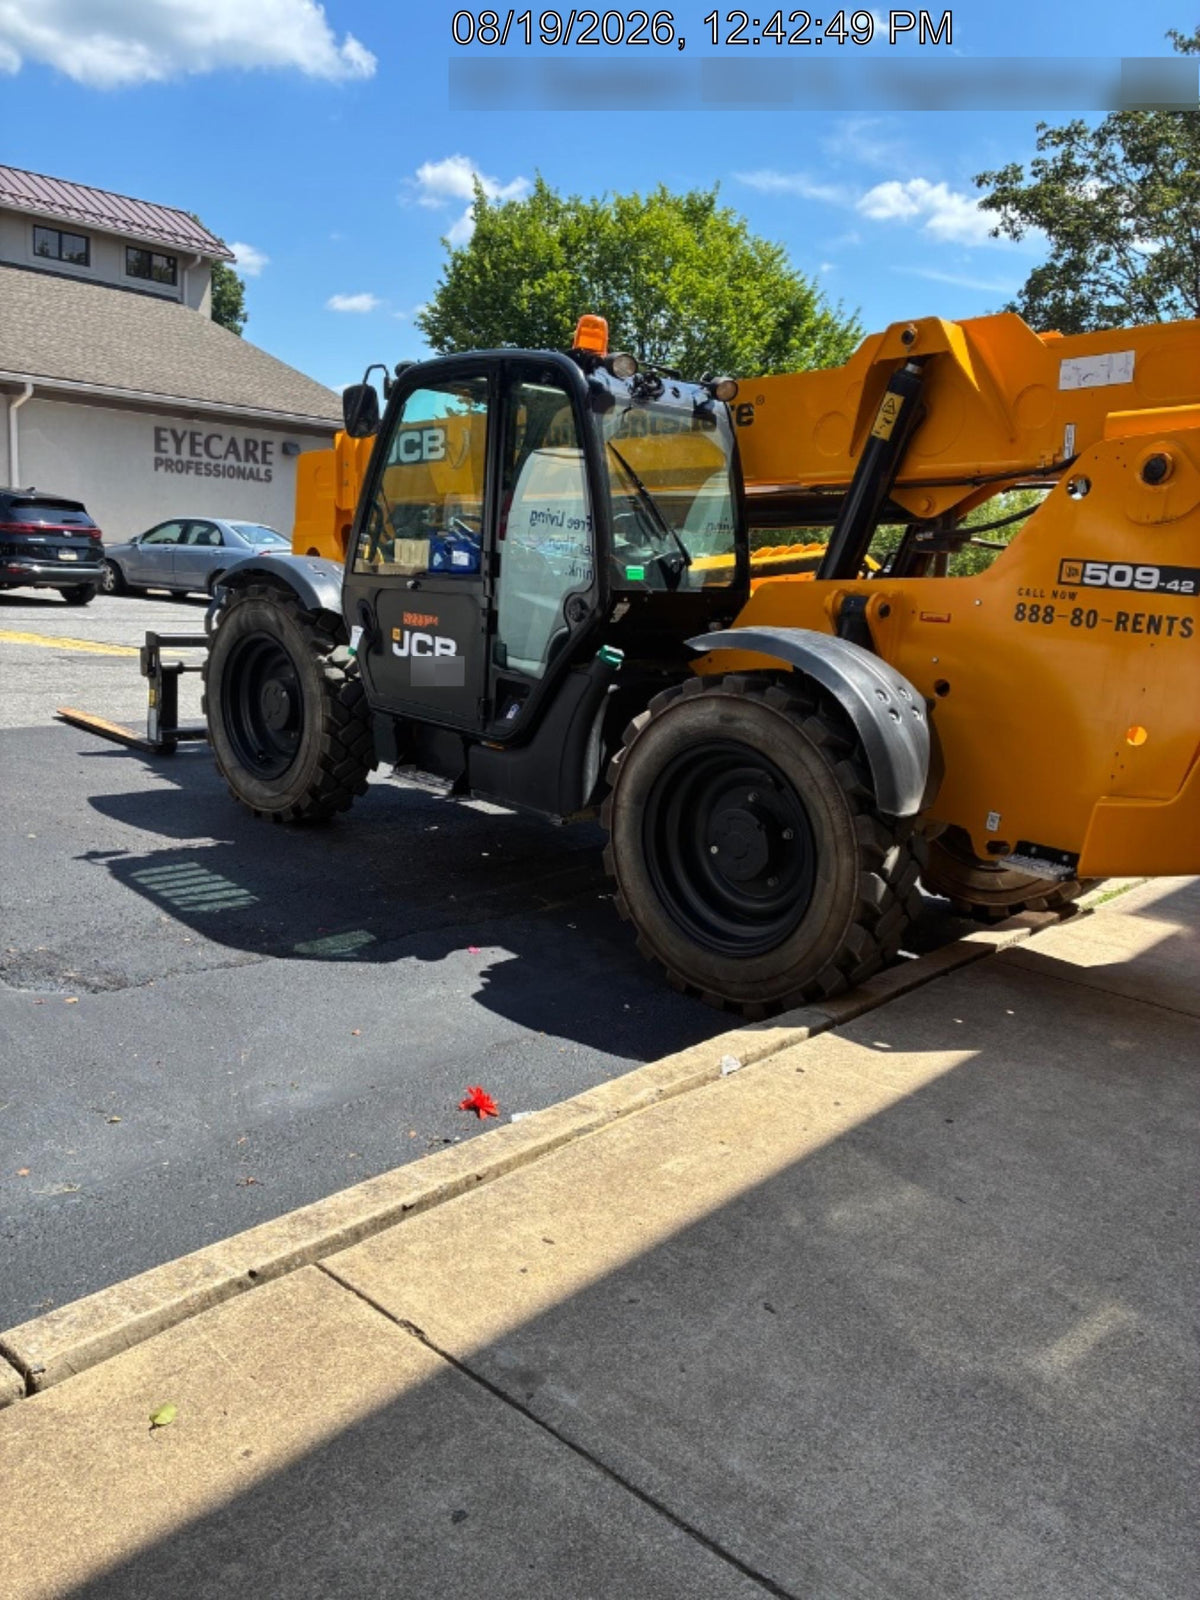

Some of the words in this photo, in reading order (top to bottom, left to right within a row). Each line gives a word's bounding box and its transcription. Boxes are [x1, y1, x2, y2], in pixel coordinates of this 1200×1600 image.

[154, 426, 274, 466] EYECARE
[154, 457, 273, 483] PROFESSIONALS
[1083, 562, 1195, 593] 509-42
[1017, 587, 1045, 598] CALL
[1051, 590, 1078, 601] NOW
[1014, 602, 1194, 639] 888-80-RENTS
[392, 630, 457, 657] JCB
